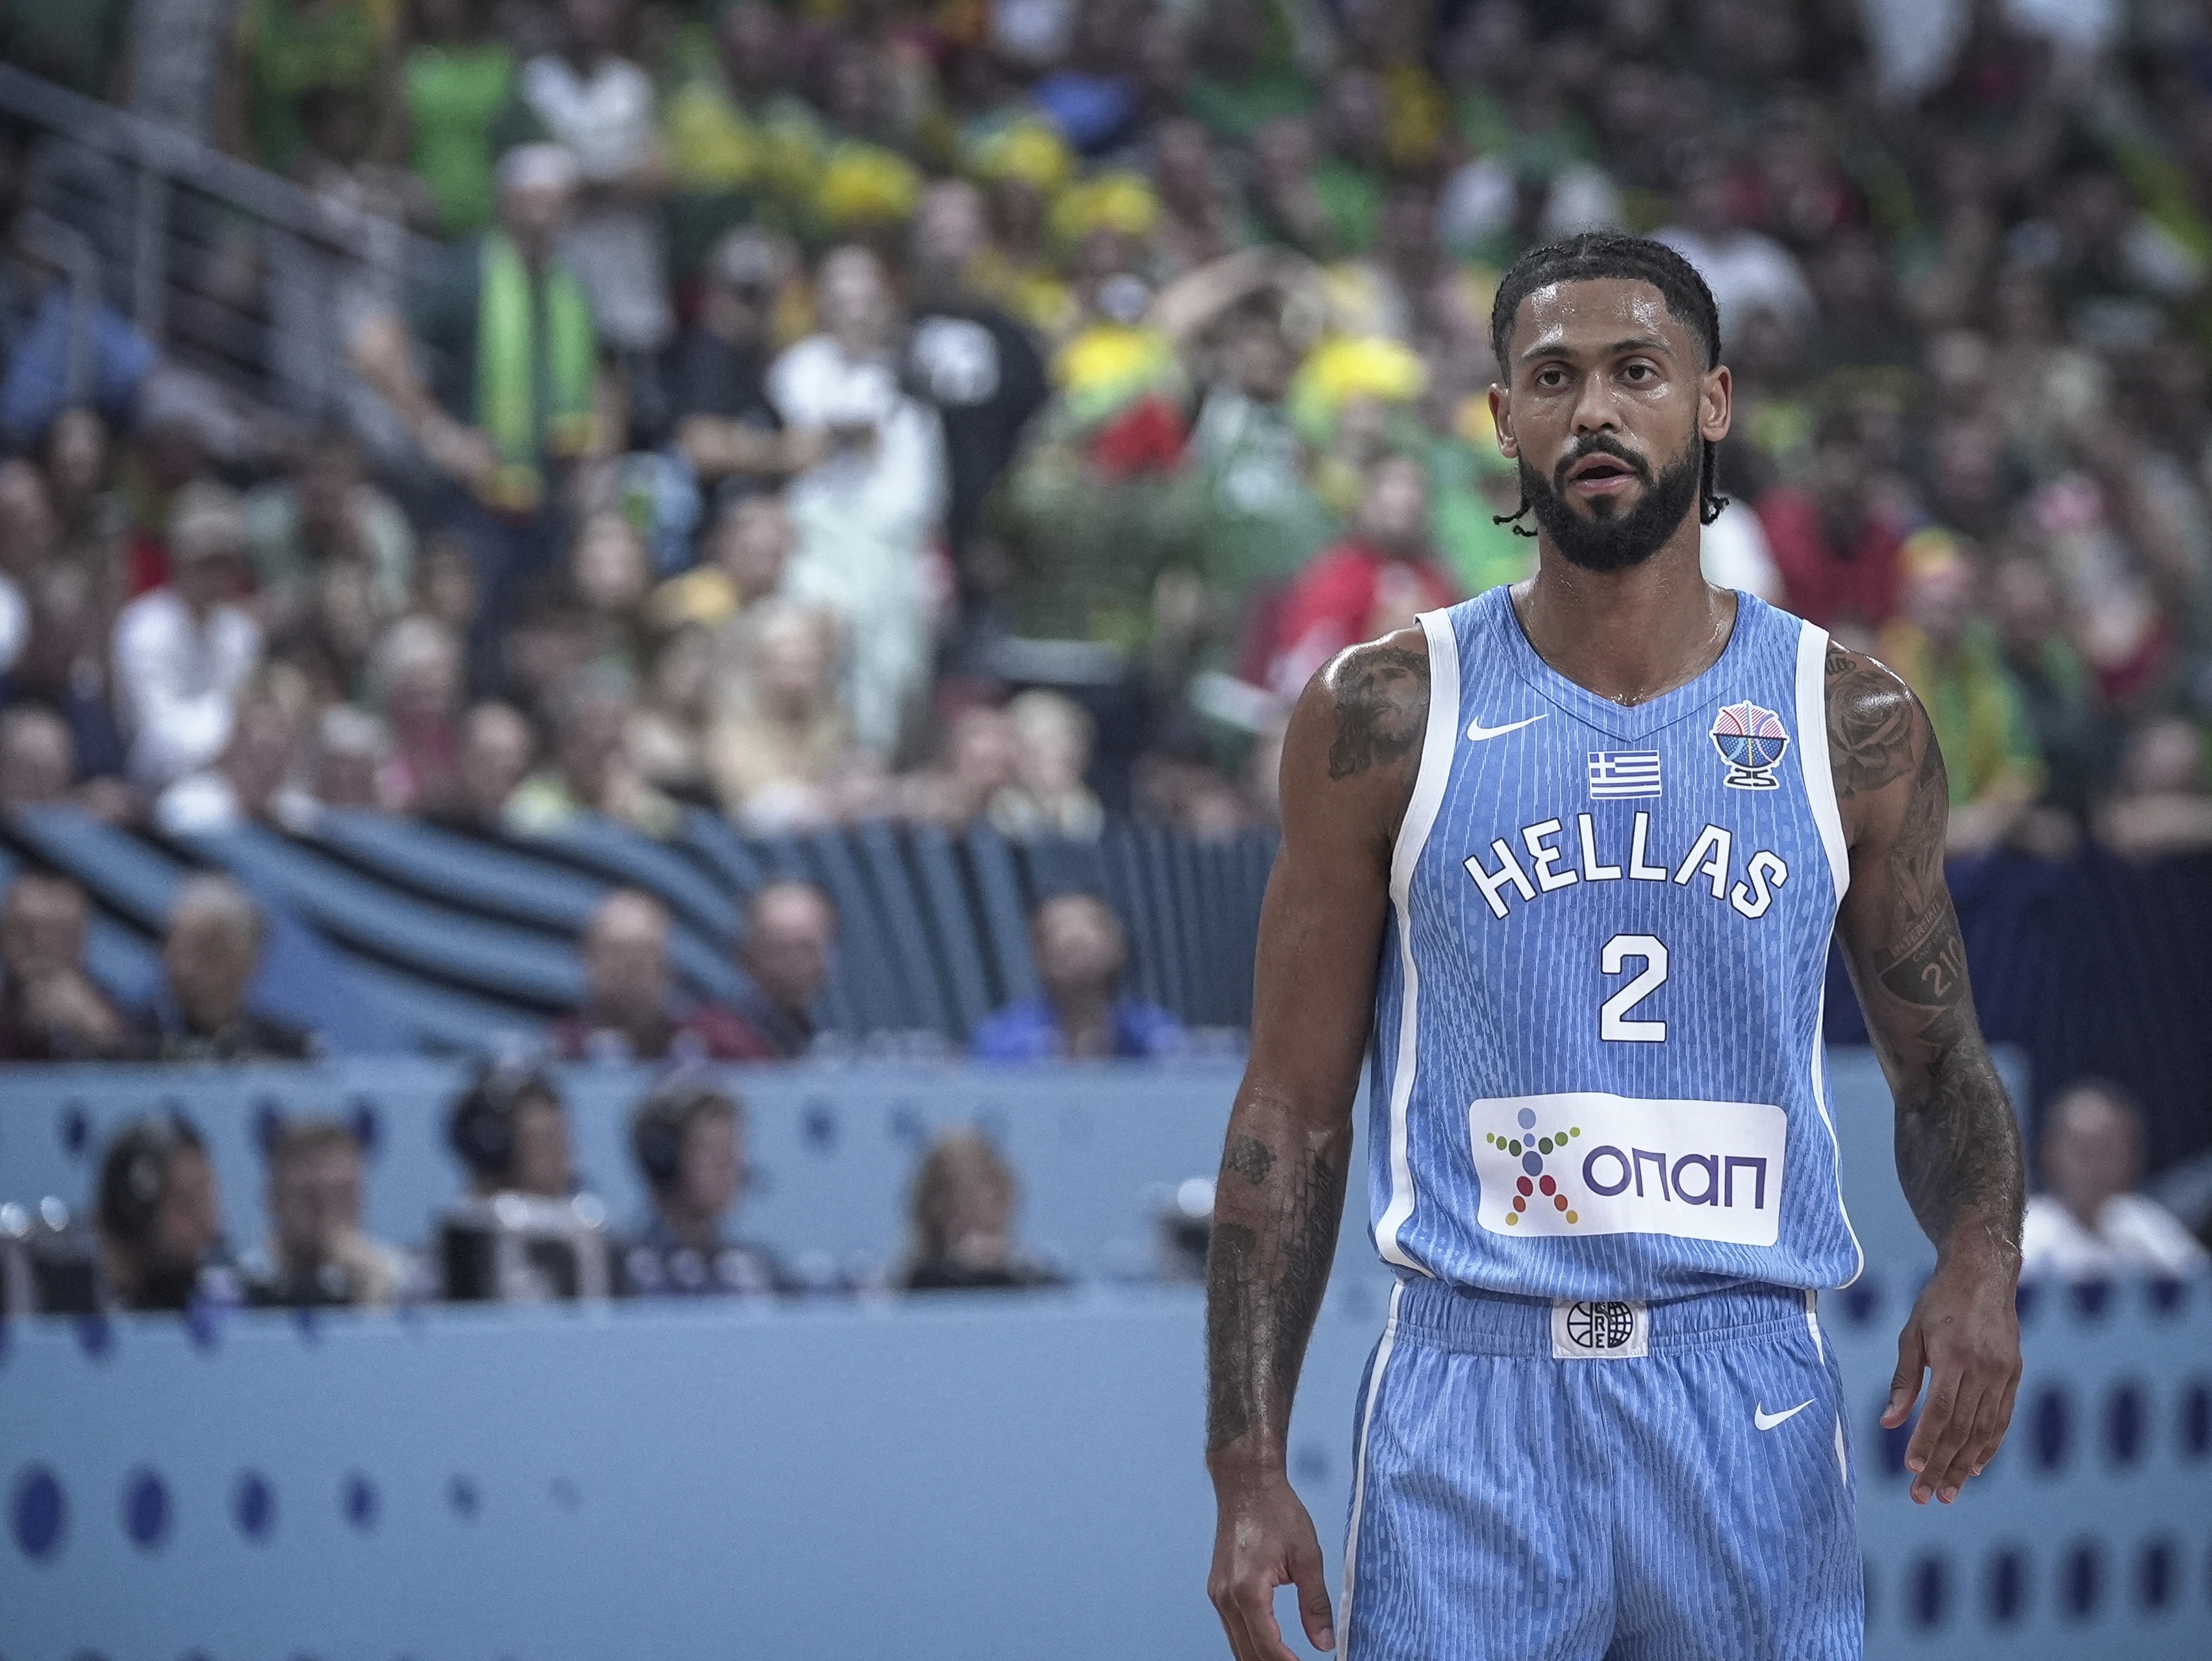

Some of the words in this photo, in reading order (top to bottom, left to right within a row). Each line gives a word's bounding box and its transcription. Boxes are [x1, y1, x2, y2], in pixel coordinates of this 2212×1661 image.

[1463, 811, 1789, 920] HELLAS
[1600, 933, 1669, 1043] 2
[1921, 935, 1967, 997] 210
